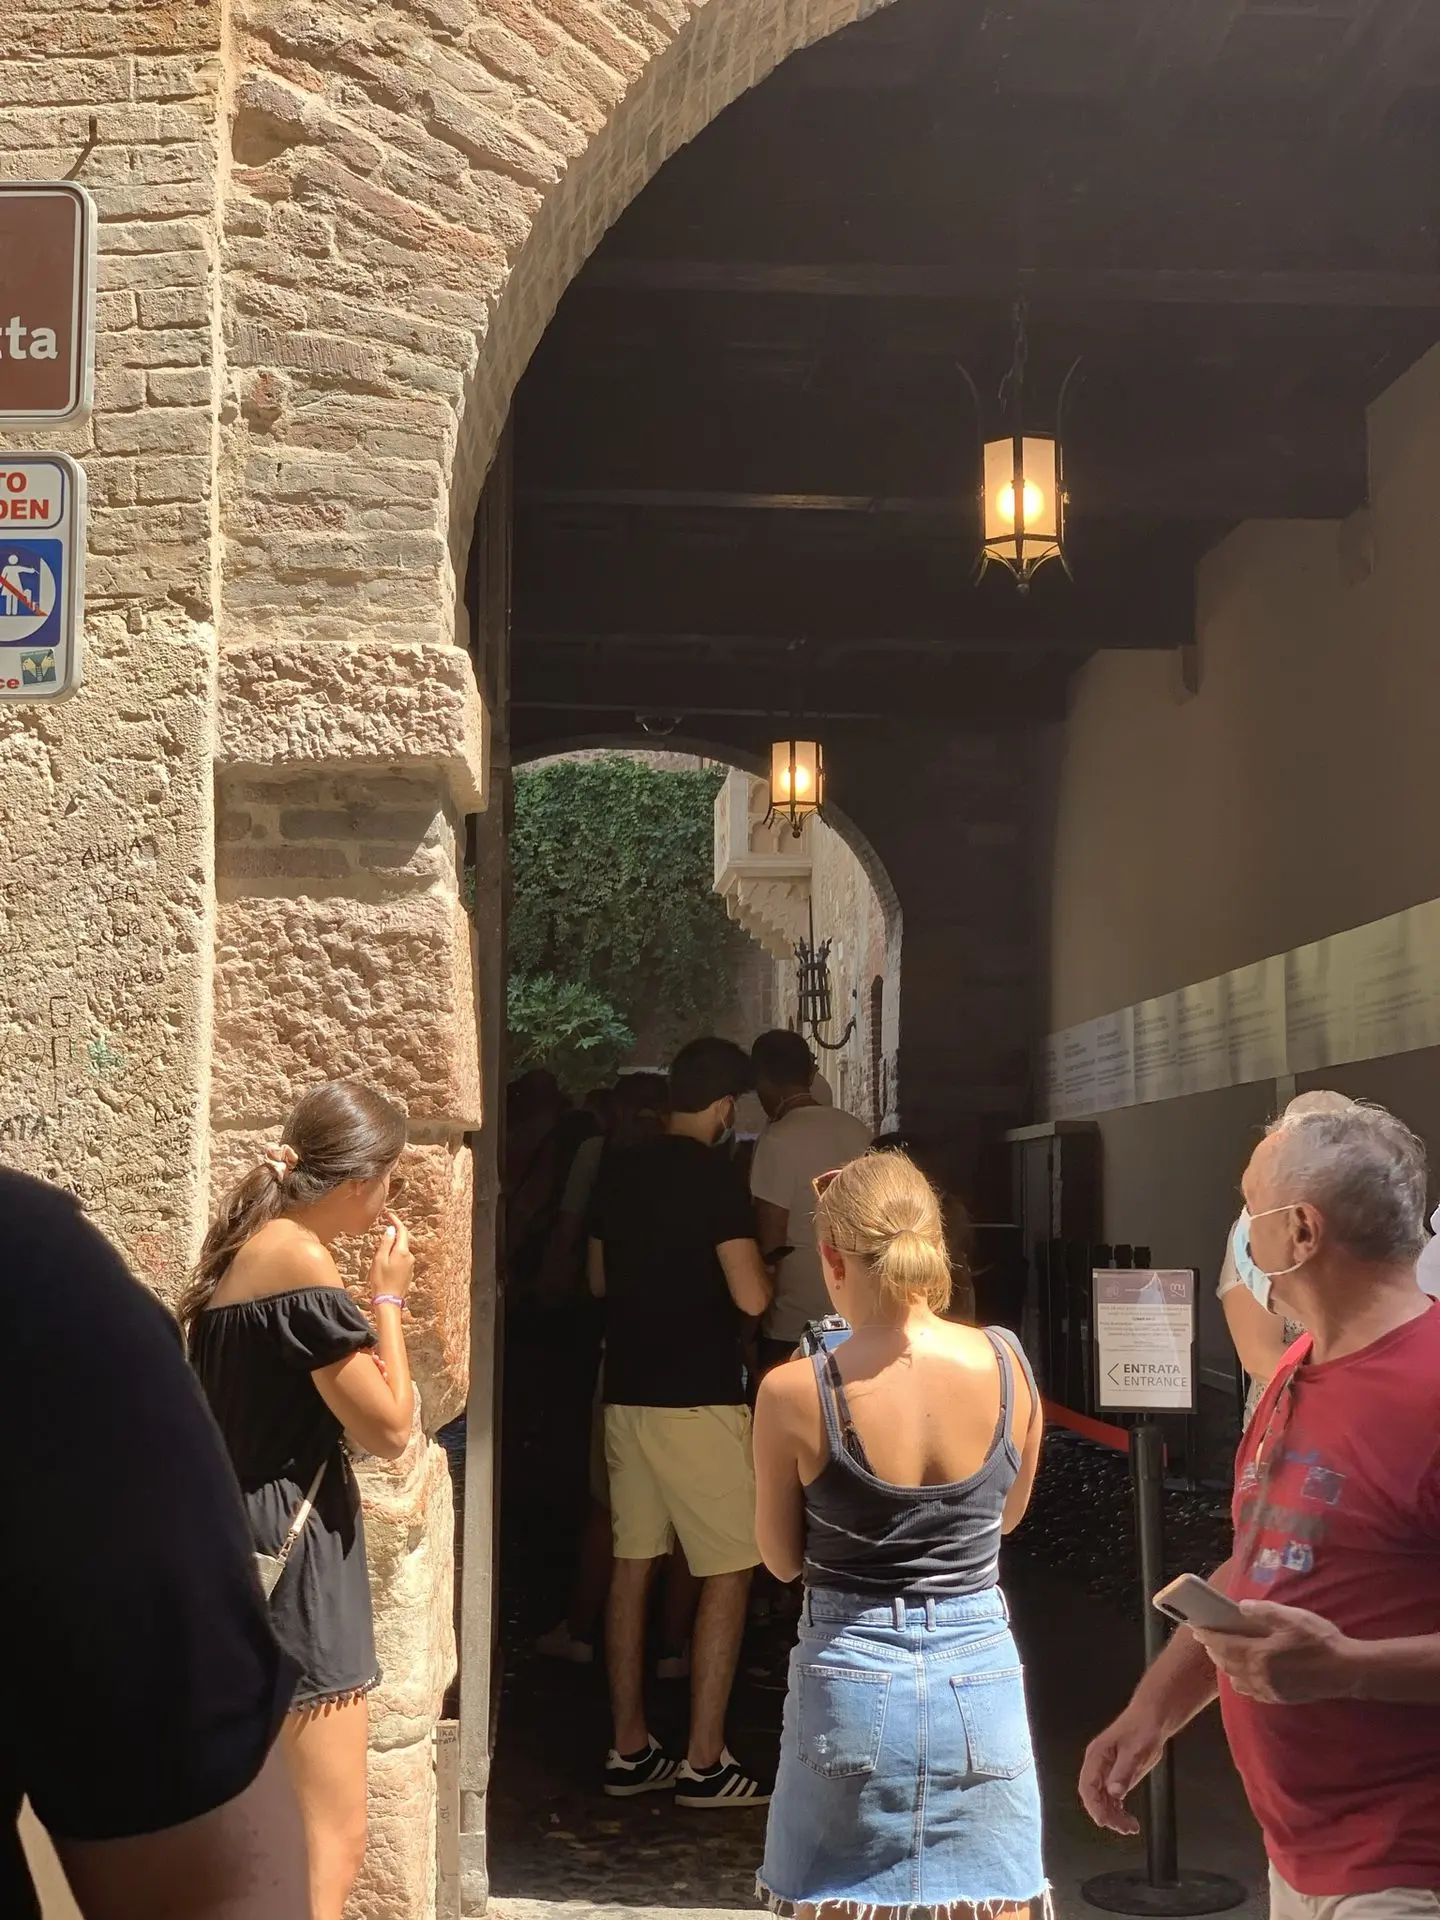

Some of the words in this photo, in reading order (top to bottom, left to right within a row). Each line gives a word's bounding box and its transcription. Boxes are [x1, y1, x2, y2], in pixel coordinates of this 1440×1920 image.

[0, 315, 59, 360] ta
[1123, 1363, 1181, 1375] ENTRATA
[1124, 1376, 1189, 1388] ENTRANCE
